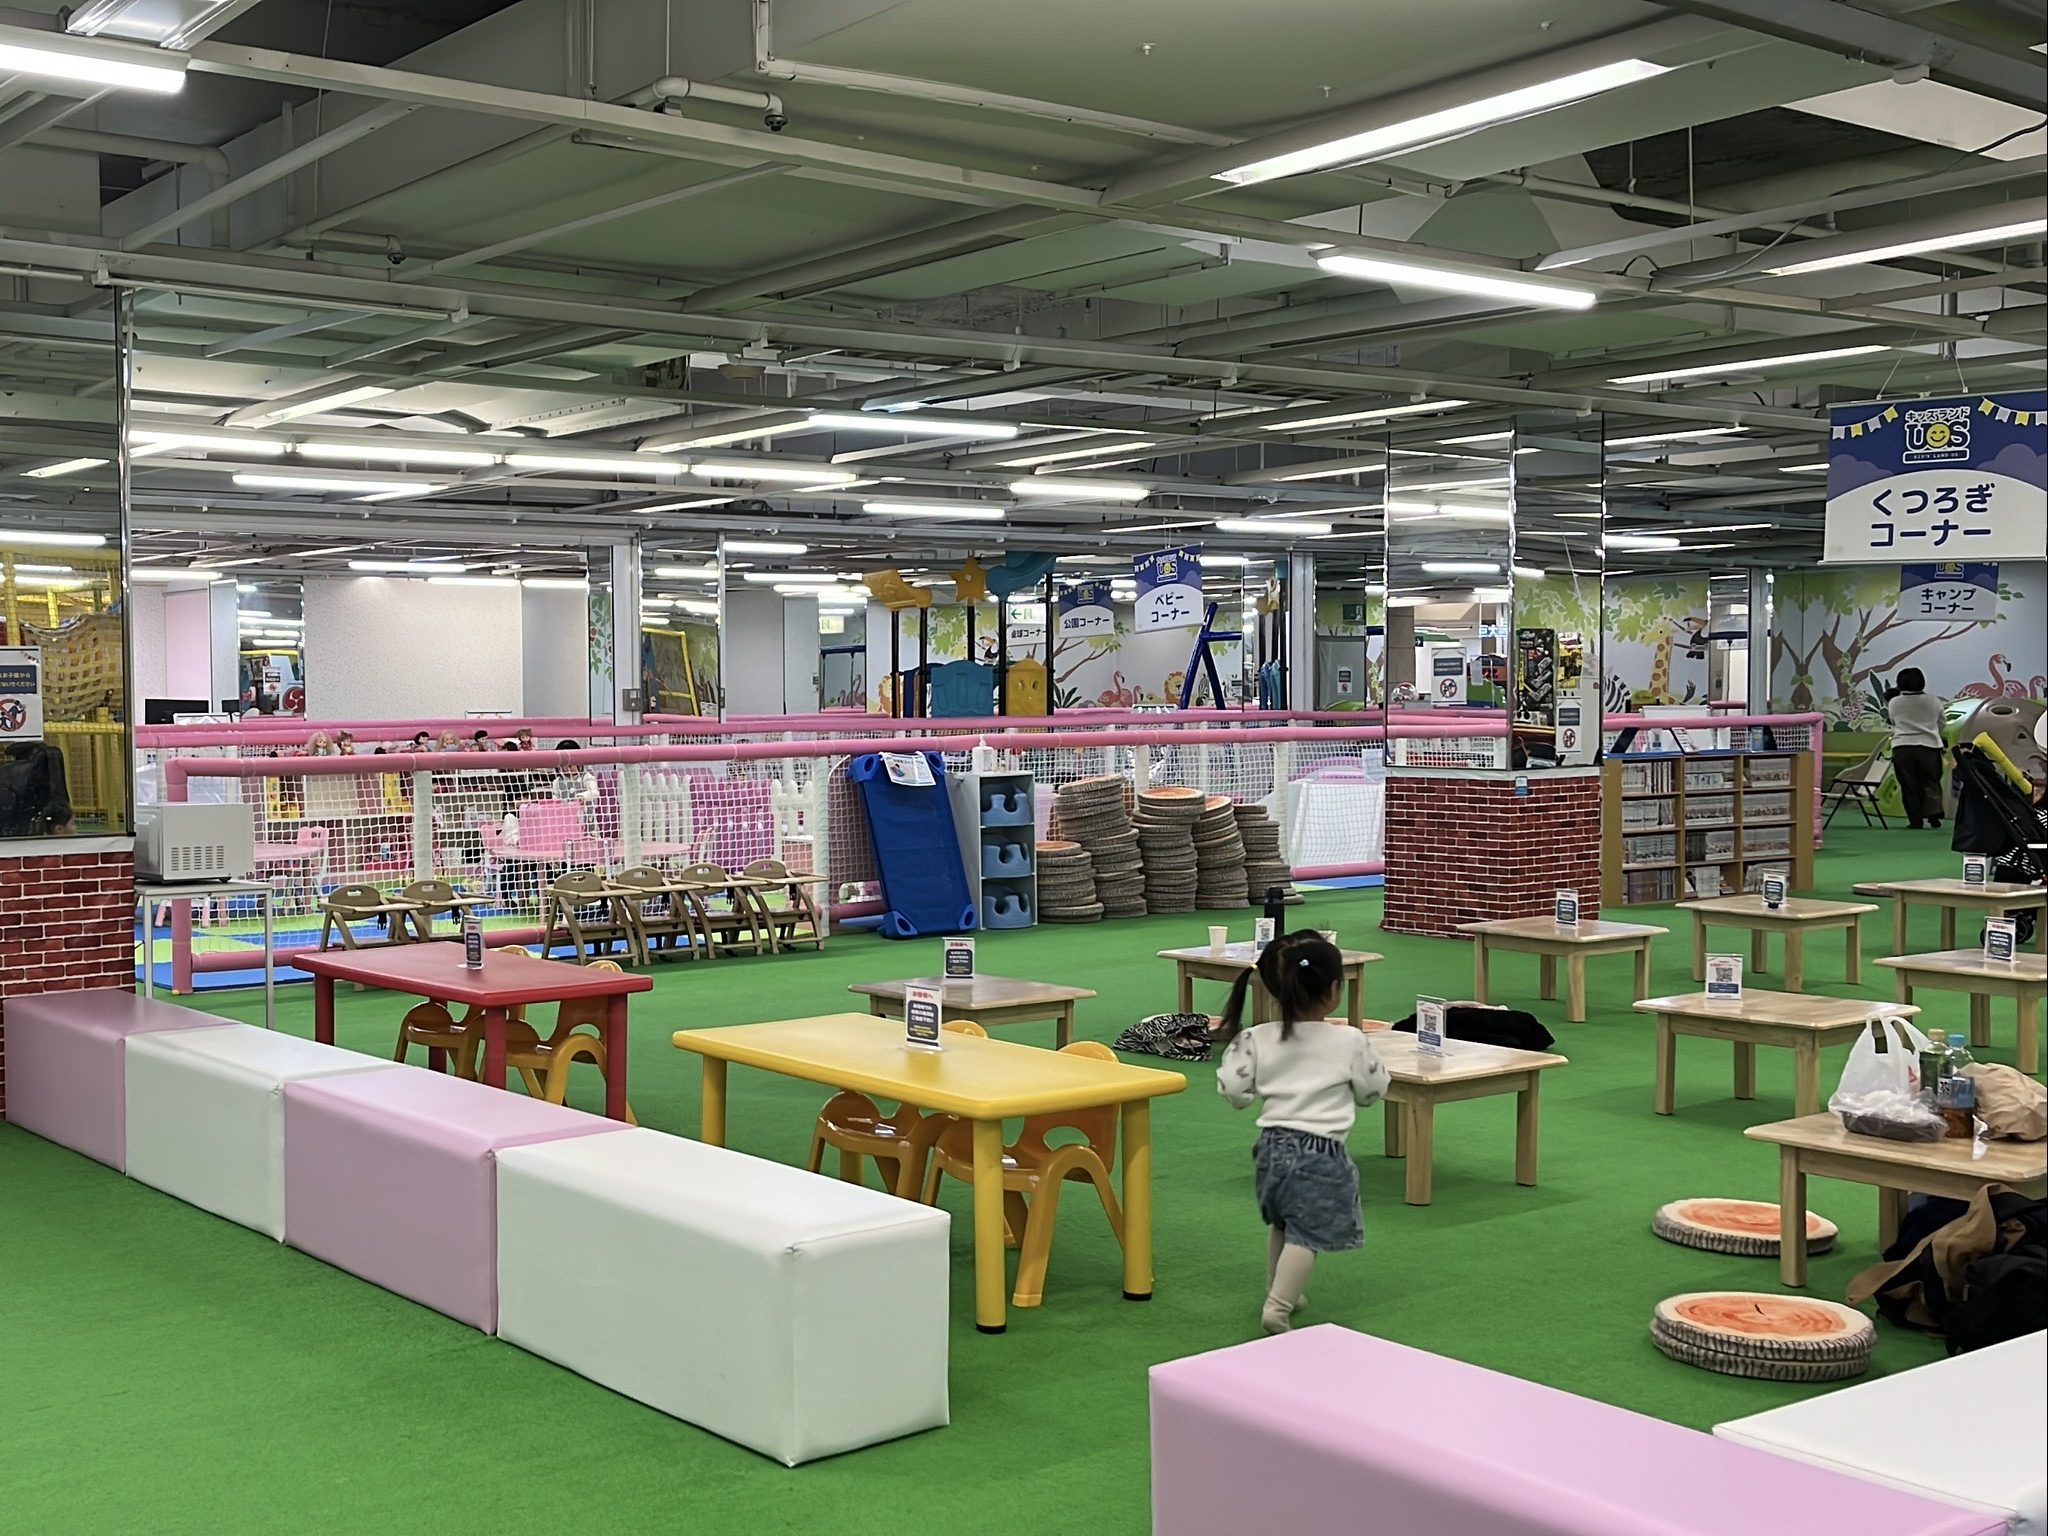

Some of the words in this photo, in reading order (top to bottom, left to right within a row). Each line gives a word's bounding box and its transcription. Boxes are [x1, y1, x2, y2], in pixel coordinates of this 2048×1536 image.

[1906, 406, 1969, 421] キッズランド
[1872, 482, 1996, 516] くつろぎ
[1870, 519, 1992, 547] コーナー
[1155, 591, 1184, 605] ベビー
[1921, 588, 1977, 601] キャンプ
[1151, 607, 1190, 623] コーナー
[1921, 602, 1974, 614] コーナー
[1064, 616, 1110, 629] 公園コーナー
